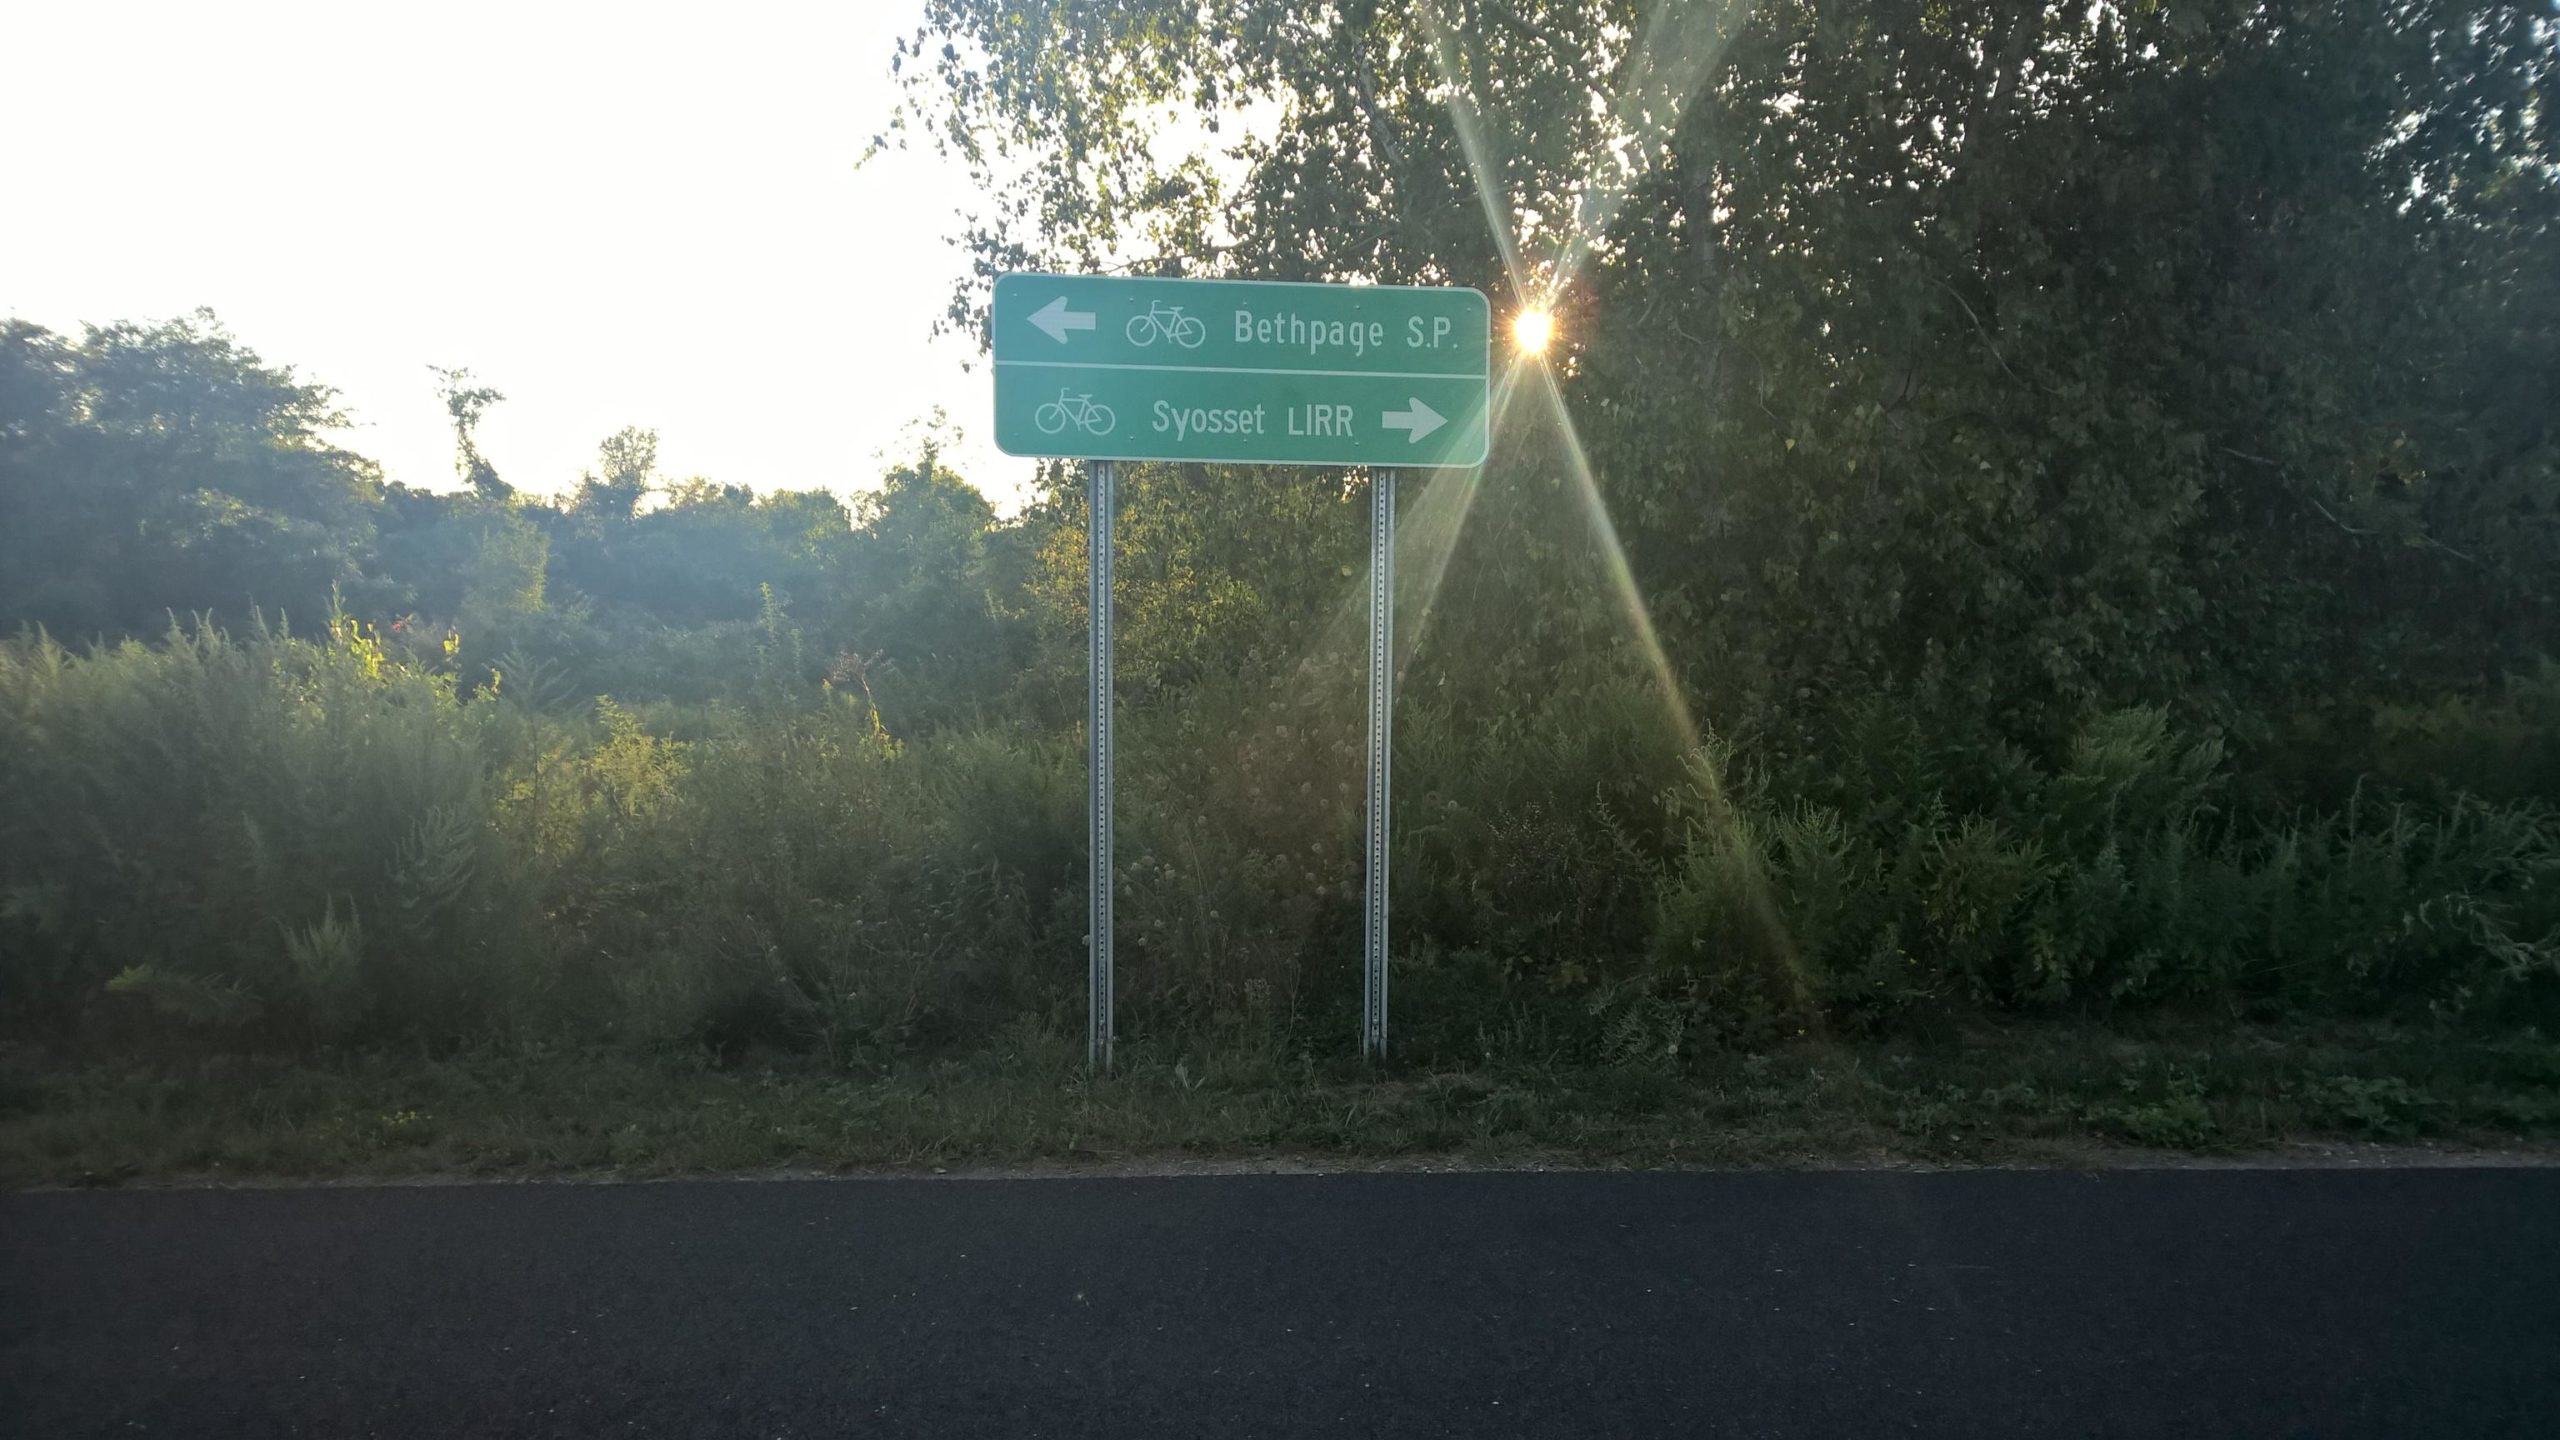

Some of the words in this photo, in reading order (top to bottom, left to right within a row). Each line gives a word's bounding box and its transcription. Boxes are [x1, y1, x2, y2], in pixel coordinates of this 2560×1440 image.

[1235, 310, 1384, 356] Bethpage
[1406, 316, 1458, 349] S.P.
[1152, 400, 1265, 441] Syosset
[1288, 404, 1354, 437] LIRR
